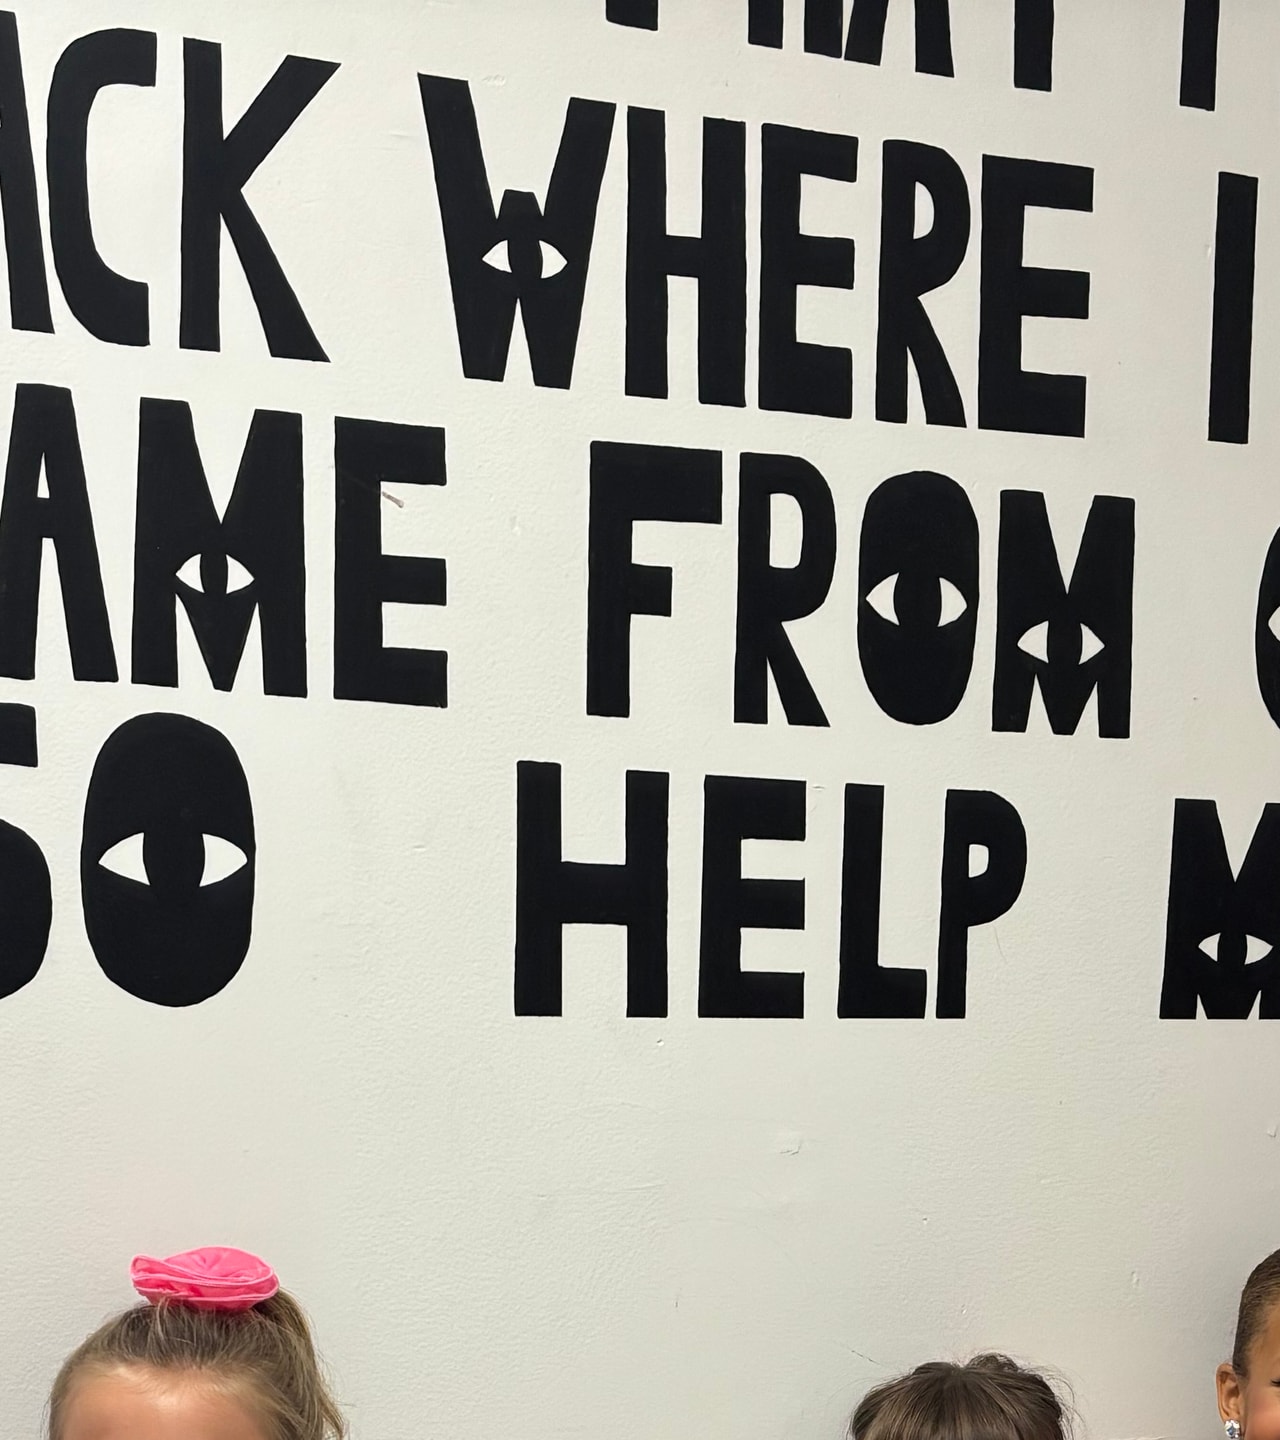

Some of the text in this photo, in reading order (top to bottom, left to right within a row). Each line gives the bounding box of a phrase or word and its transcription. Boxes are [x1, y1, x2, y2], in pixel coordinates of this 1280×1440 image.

[417, 72, 1095, 447] WHERE
[586, 440, 1136, 739] FROM
[513, 760, 1028, 1020] HELP
